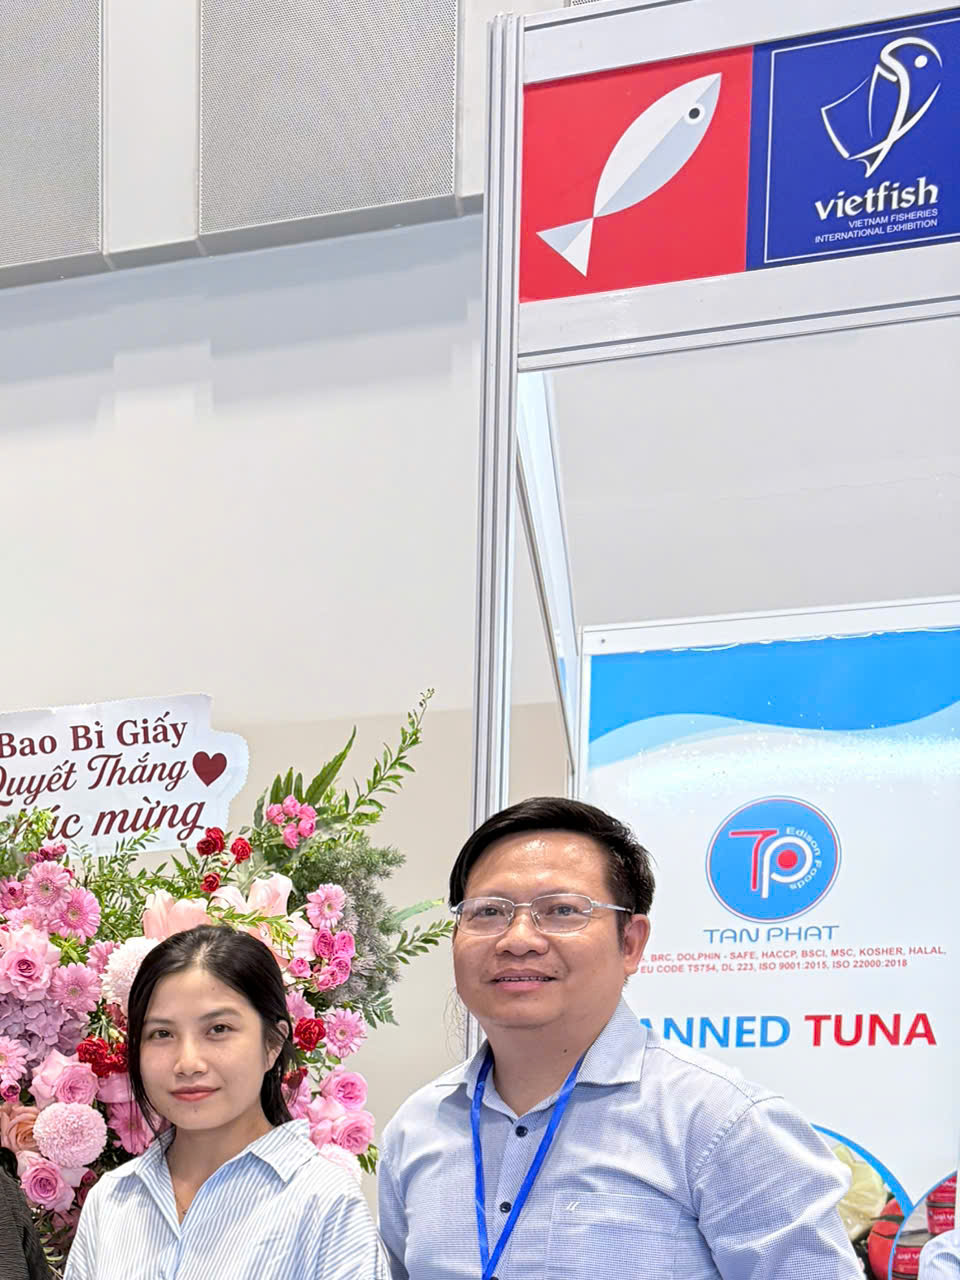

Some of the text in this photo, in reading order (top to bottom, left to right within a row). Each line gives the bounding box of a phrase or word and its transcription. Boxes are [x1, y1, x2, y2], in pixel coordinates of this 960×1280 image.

[814, 176, 939, 221] vietfish
[814, 218, 938, 244] INTERNATIONAL EXHIBITION
[848, 208, 939, 228] VIETNAM FISHERIES
[116, 711, 189, 749] Giấy
[87, 751, 190, 792] Thắng
[91, 796, 207, 841] mừng
[785, 826, 822, 857] Edison
[788, 859, 823, 890] Foods
[703, 925, 841, 944] TAN PHAT
[640, 965, 655, 974] EU
[656, 964, 685, 974] CODE
[721, 963, 735, 972] DL
[759, 962, 777, 970] ISO
[832, 960, 850, 969] ISO
[852, 959, 908, 969] 22000:2018
[676, 952, 721, 962] DOLPHIN
[640, 1013, 938, 1049] NNED TUNA
